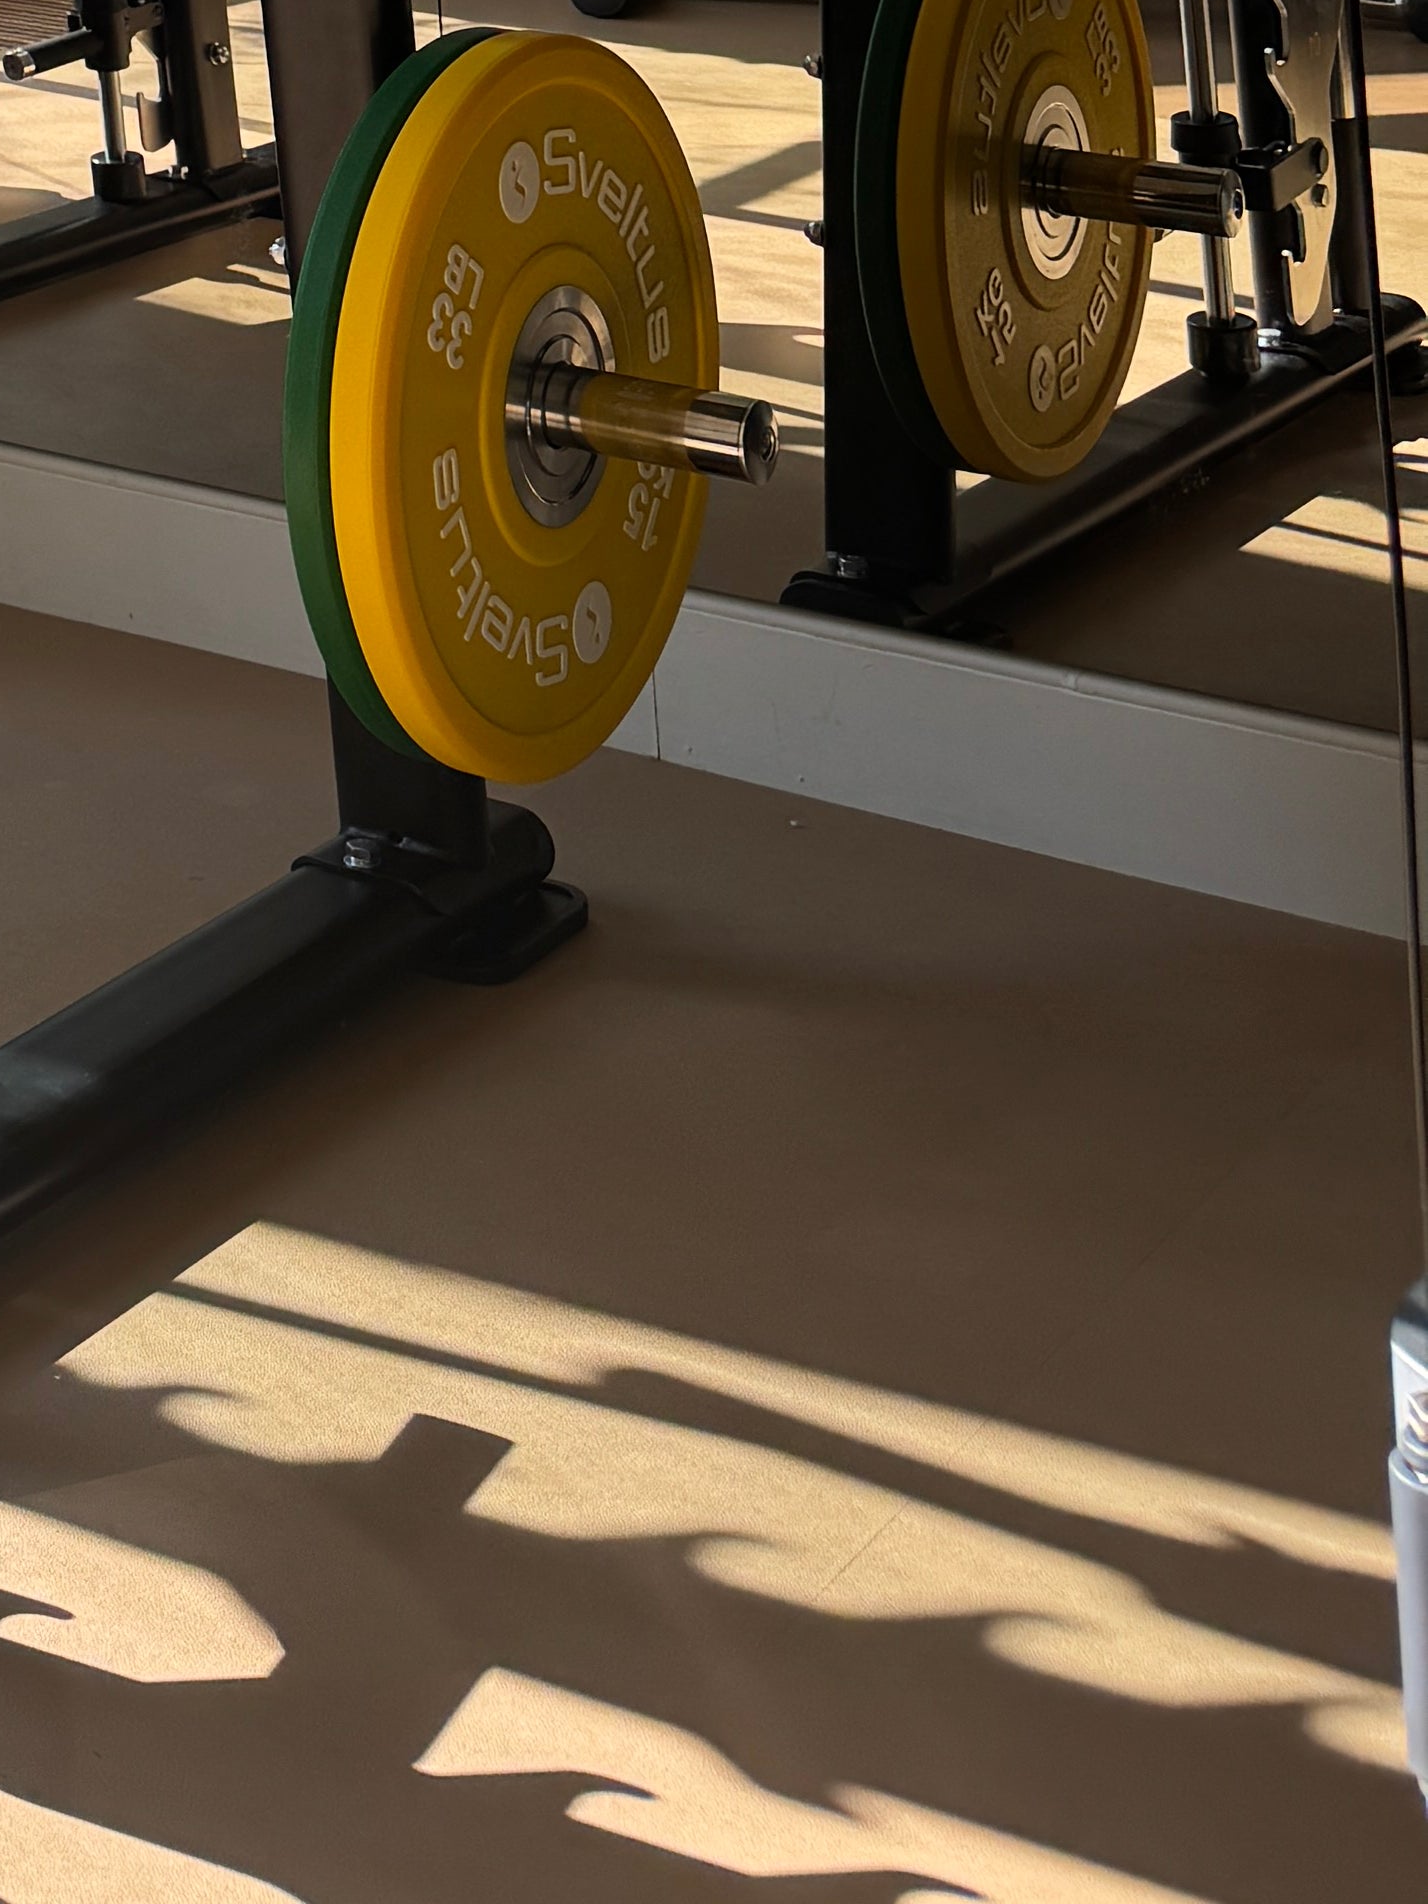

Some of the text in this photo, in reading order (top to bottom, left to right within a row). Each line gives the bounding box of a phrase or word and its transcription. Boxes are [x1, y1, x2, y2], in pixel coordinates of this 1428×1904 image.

[444, 244, 484, 310] LB
[543, 128, 670, 363] Sveltus
[427, 292, 473, 370] 33
[623, 482, 660, 552] 15
[433, 447, 569, 687] Sveltus
